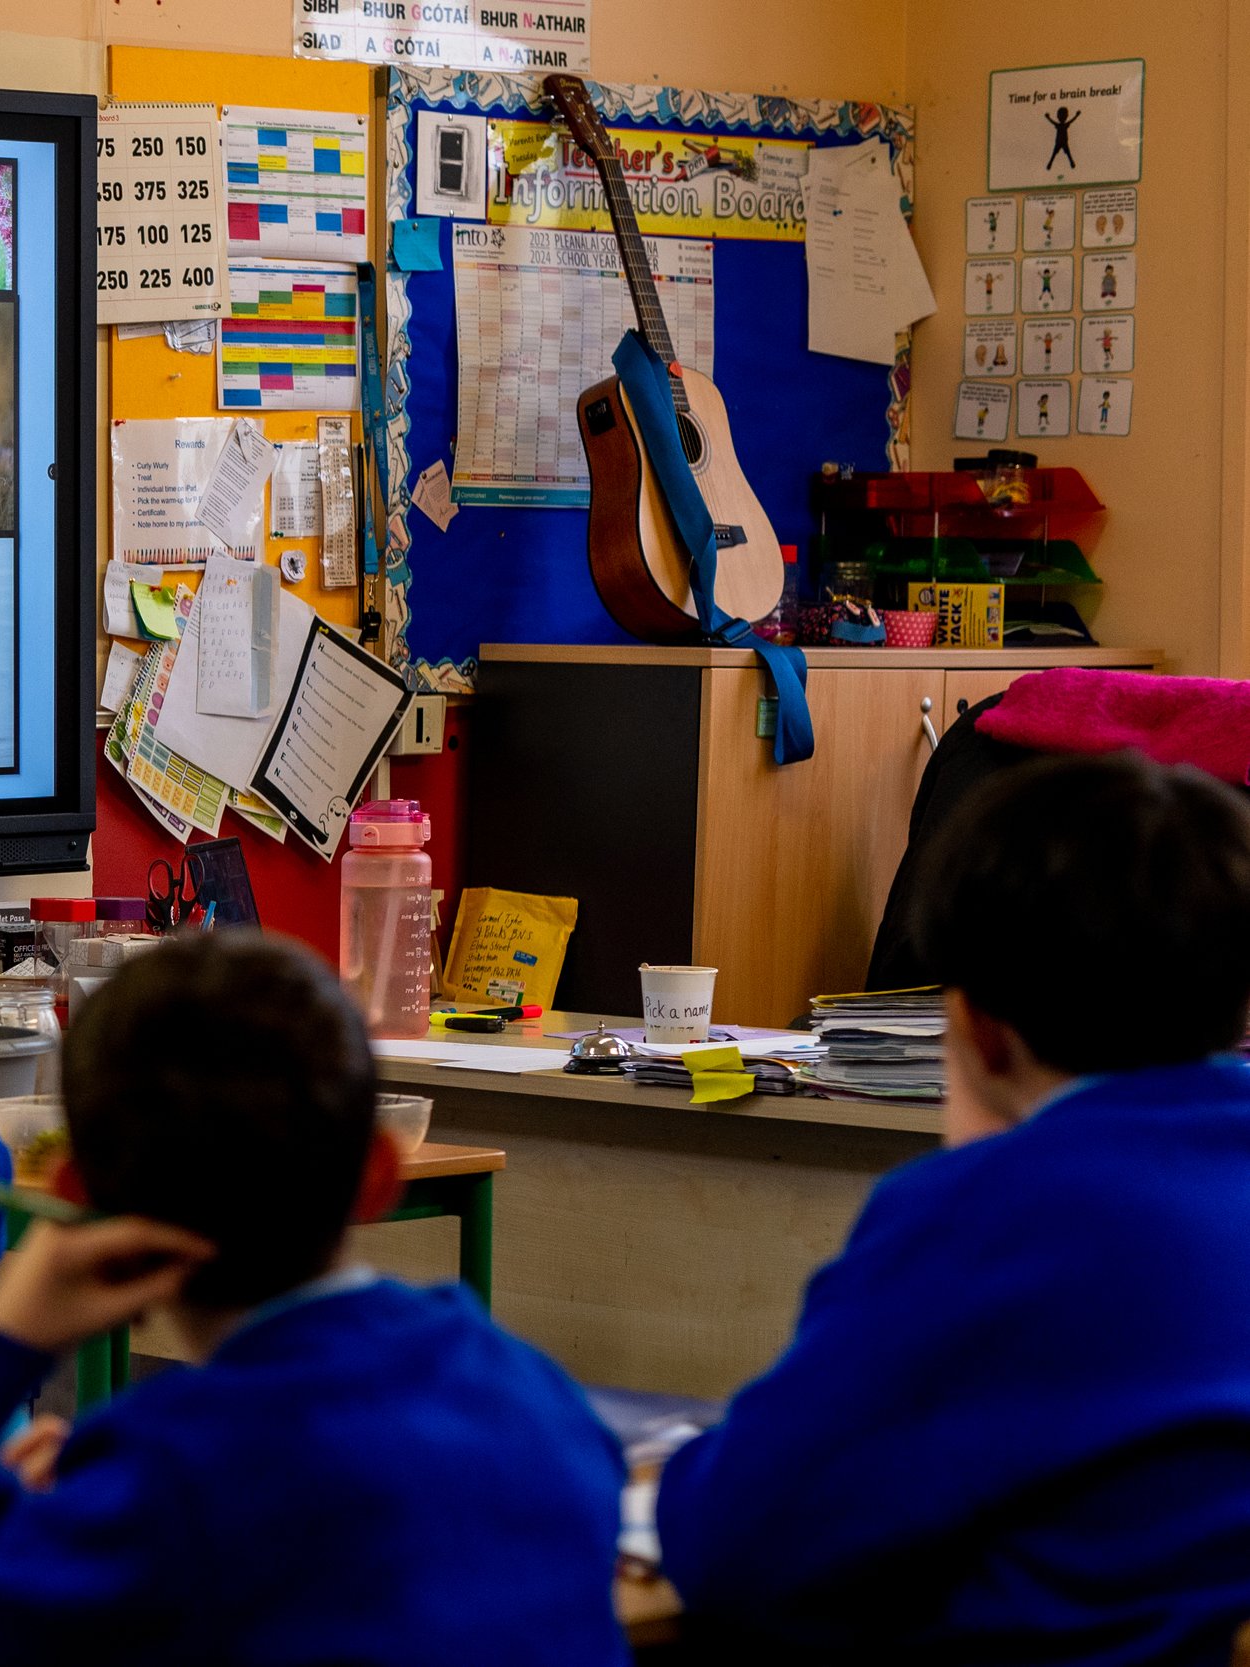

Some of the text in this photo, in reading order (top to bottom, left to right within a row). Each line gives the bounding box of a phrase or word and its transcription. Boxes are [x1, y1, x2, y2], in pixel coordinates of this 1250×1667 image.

[302, 0, 339, 14] SIBH
[363, 2, 469, 25] BHUR GCÓTAÍ
[480, 10, 586, 33] BHUR N-ATHAIR
[302, 32, 341, 50] SIAD
[365, 35, 440, 57] A GCÓTAÍ
[483, 46, 493, 62] A
[1008, 93, 1031, 104] Time
[1032, 91, 1047, 104] for
[1059, 88, 1086, 100] brain
[1089, 85, 1122, 97] break!
[131, 137, 164, 156] 250
[175, 136, 206, 156] 150
[558, 134, 674, 173] Teher's
[686, 154, 706, 175] pen
[134, 181, 166, 201] 375
[177, 180, 209, 200] 325
[494, 162, 702, 224] Informtion
[97, 226, 126, 246] 175
[137, 224, 168, 245] 100
[180, 223, 212, 243] 125
[455, 226, 488, 247] into
[529, 232, 551, 248] 2023
[529, 250, 551, 265] 2024
[557, 250, 590, 267] SCHOOL
[593, 253, 617, 269] YEAR
[97, 270, 128, 290] 250
[139, 268, 171, 288] 225
[182, 267, 214, 287] 400
[175, 439, 205, 449] Rewards
[137, 462, 169, 470] Curly Wurly
[937, 590, 949, 645] WHITE
[950, 603, 962, 645] TACK
[10, 914, 25, 922] Pass
[13, 945, 34, 953] OFFICE
[645, 996, 665, 1019] Pick
[669, 1008, 680, 1019] a
